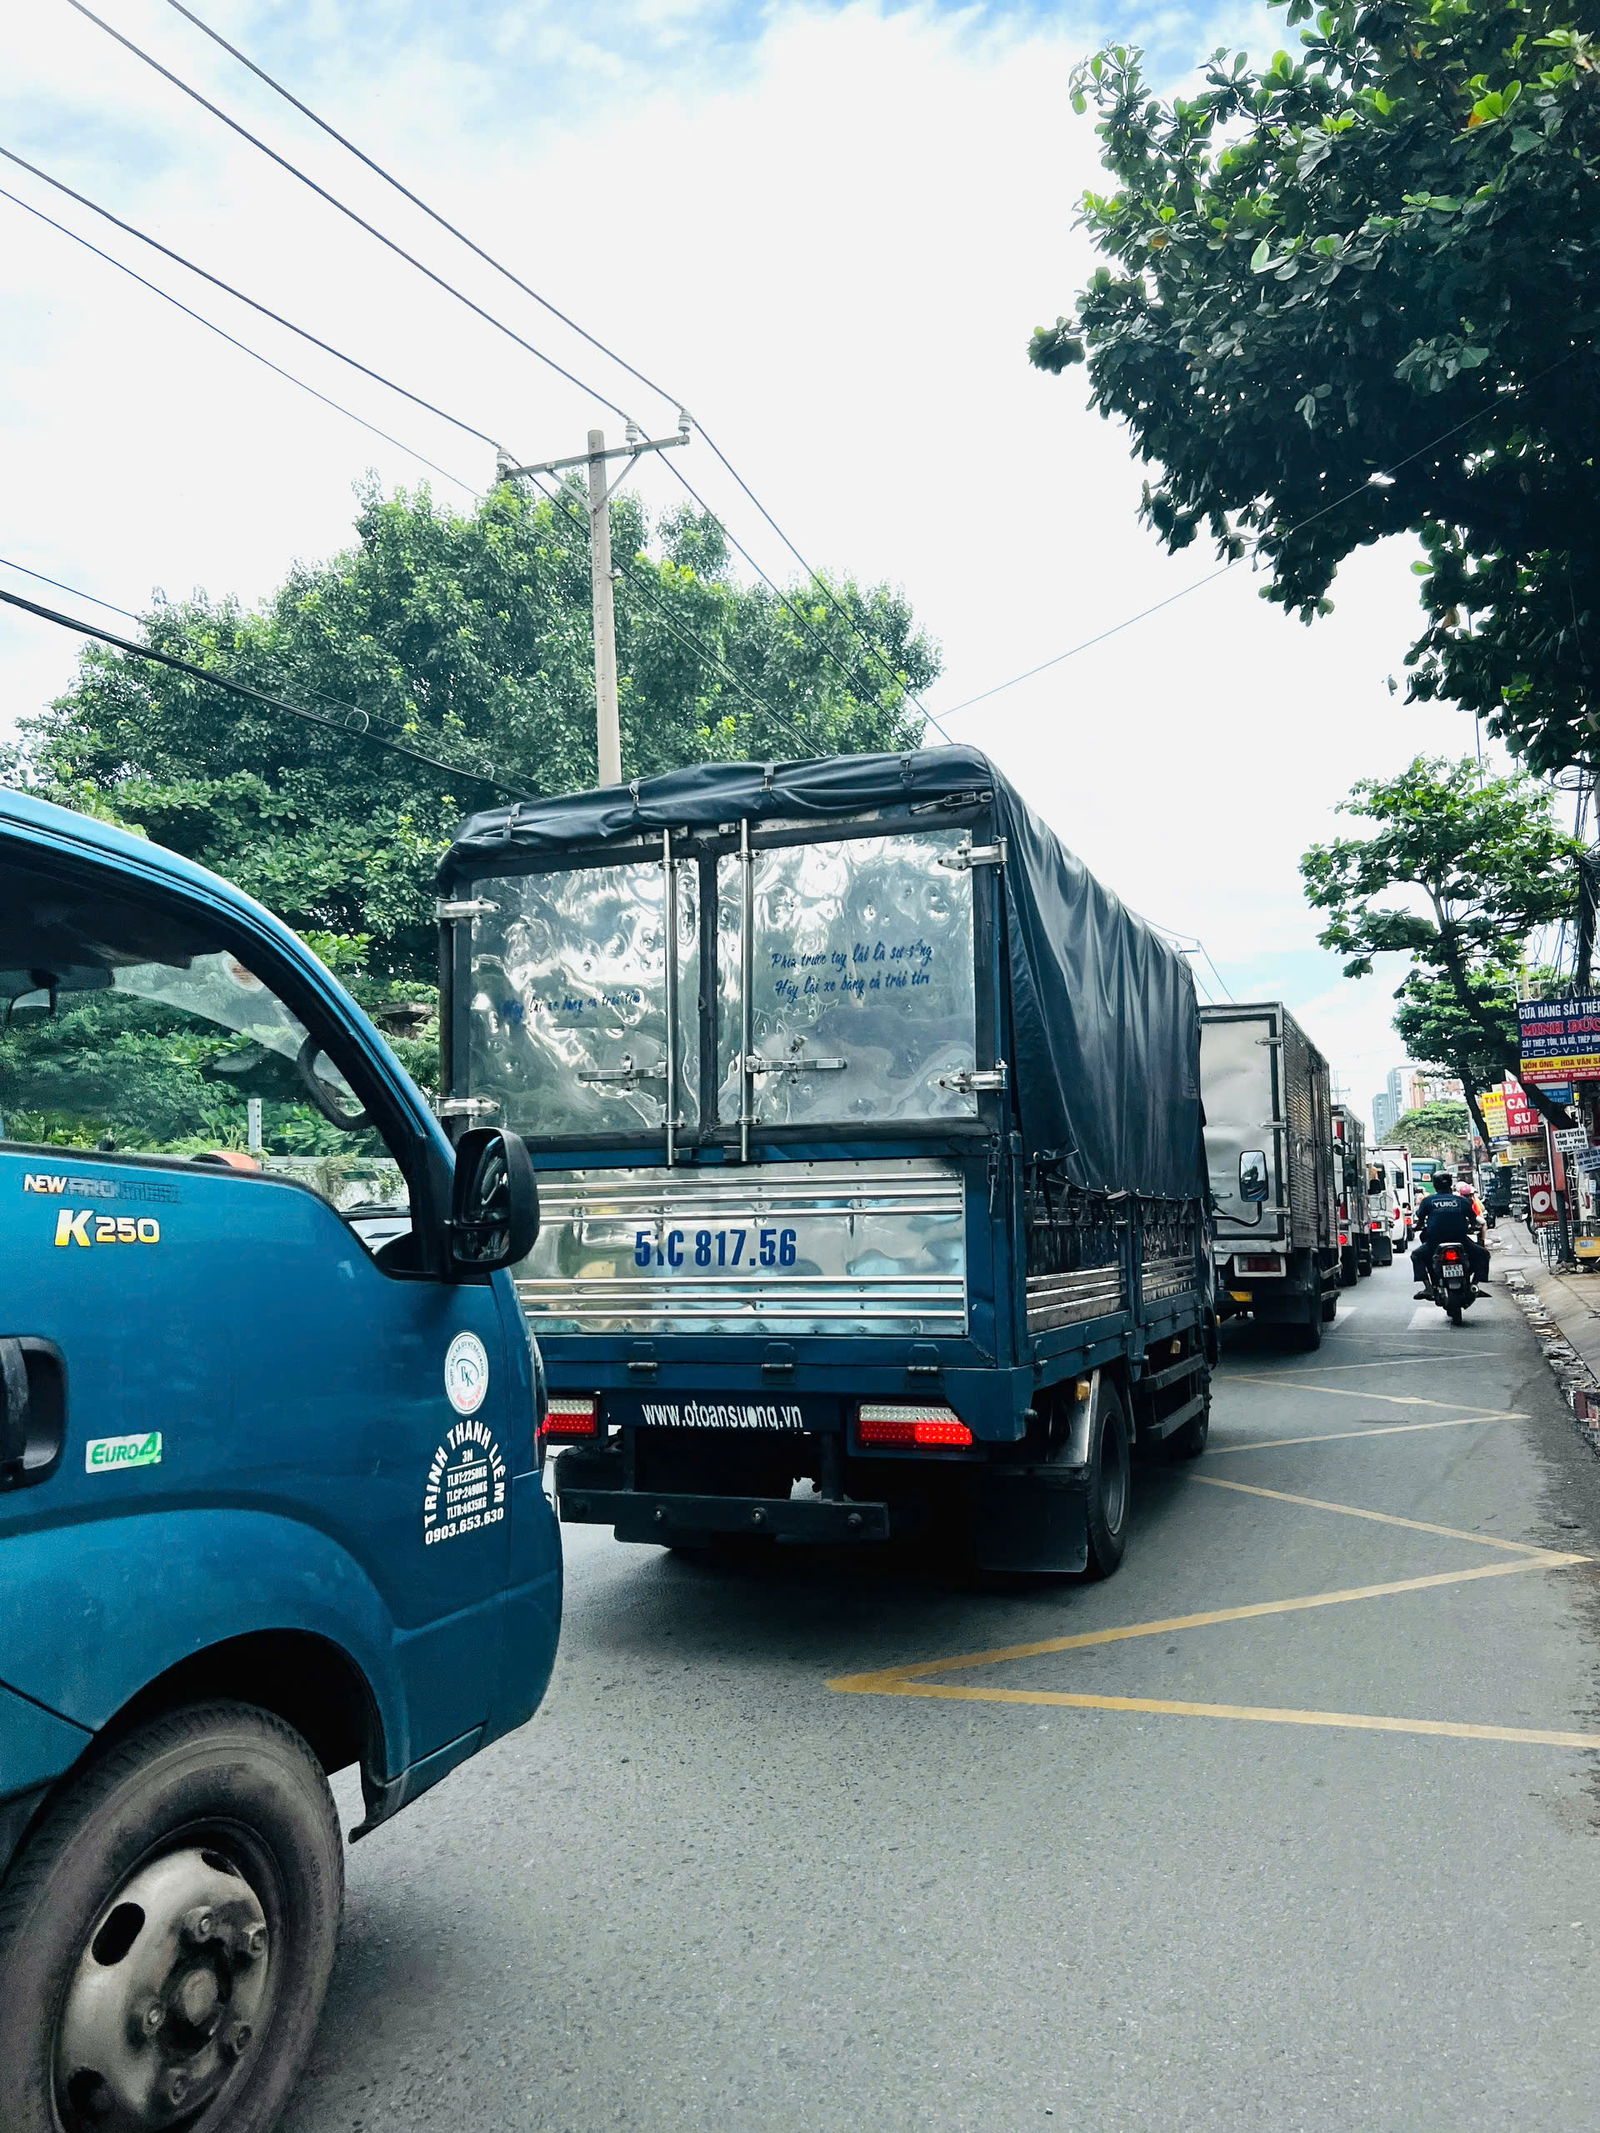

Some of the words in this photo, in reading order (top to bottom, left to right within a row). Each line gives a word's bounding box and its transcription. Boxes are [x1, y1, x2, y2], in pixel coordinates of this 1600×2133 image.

[908, 938, 933, 966] sng
[1537, 1003, 1562, 1018] HÀNG
[1521, 1020, 1565, 1037] MINH
[1503, 1083, 1524, 1095] BA
[1506, 1098, 1527, 1110] CA
[1513, 1112, 1531, 1125] SU
[23, 1173, 68, 1194] NEW
[1528, 1173, 1542, 1186] BAO
[695, 1228, 797, 1267] 817.56
[447, 1419, 493, 1451] THANH
[425, 1507, 505, 1546] 0903.653.630
